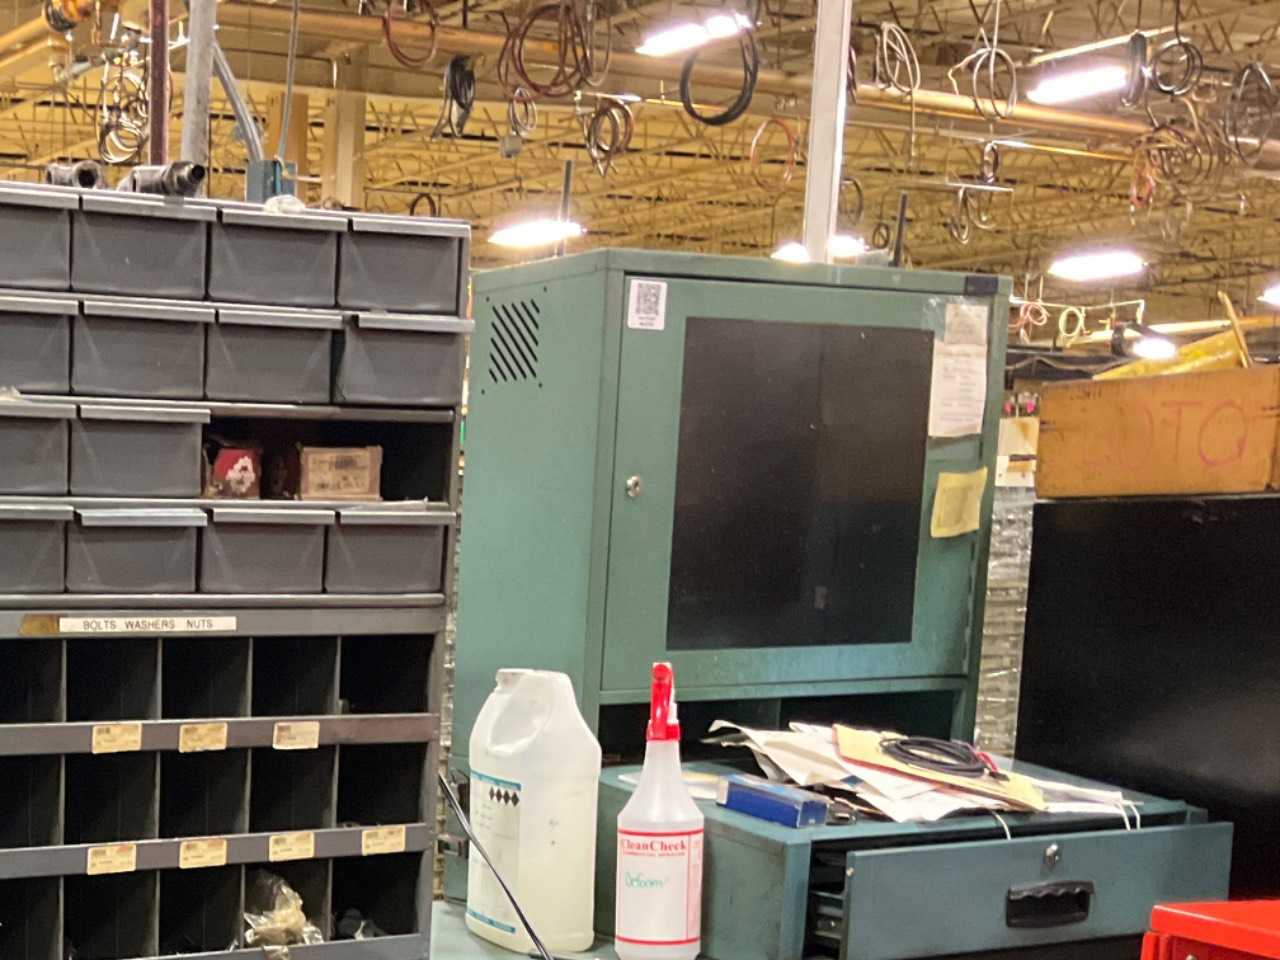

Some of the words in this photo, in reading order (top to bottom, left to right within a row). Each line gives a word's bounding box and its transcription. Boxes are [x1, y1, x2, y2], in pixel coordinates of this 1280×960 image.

[83, 619, 117, 631] BOLTS
[125, 619, 176, 630] WASHERS
[186, 618, 213, 629] NUTS
